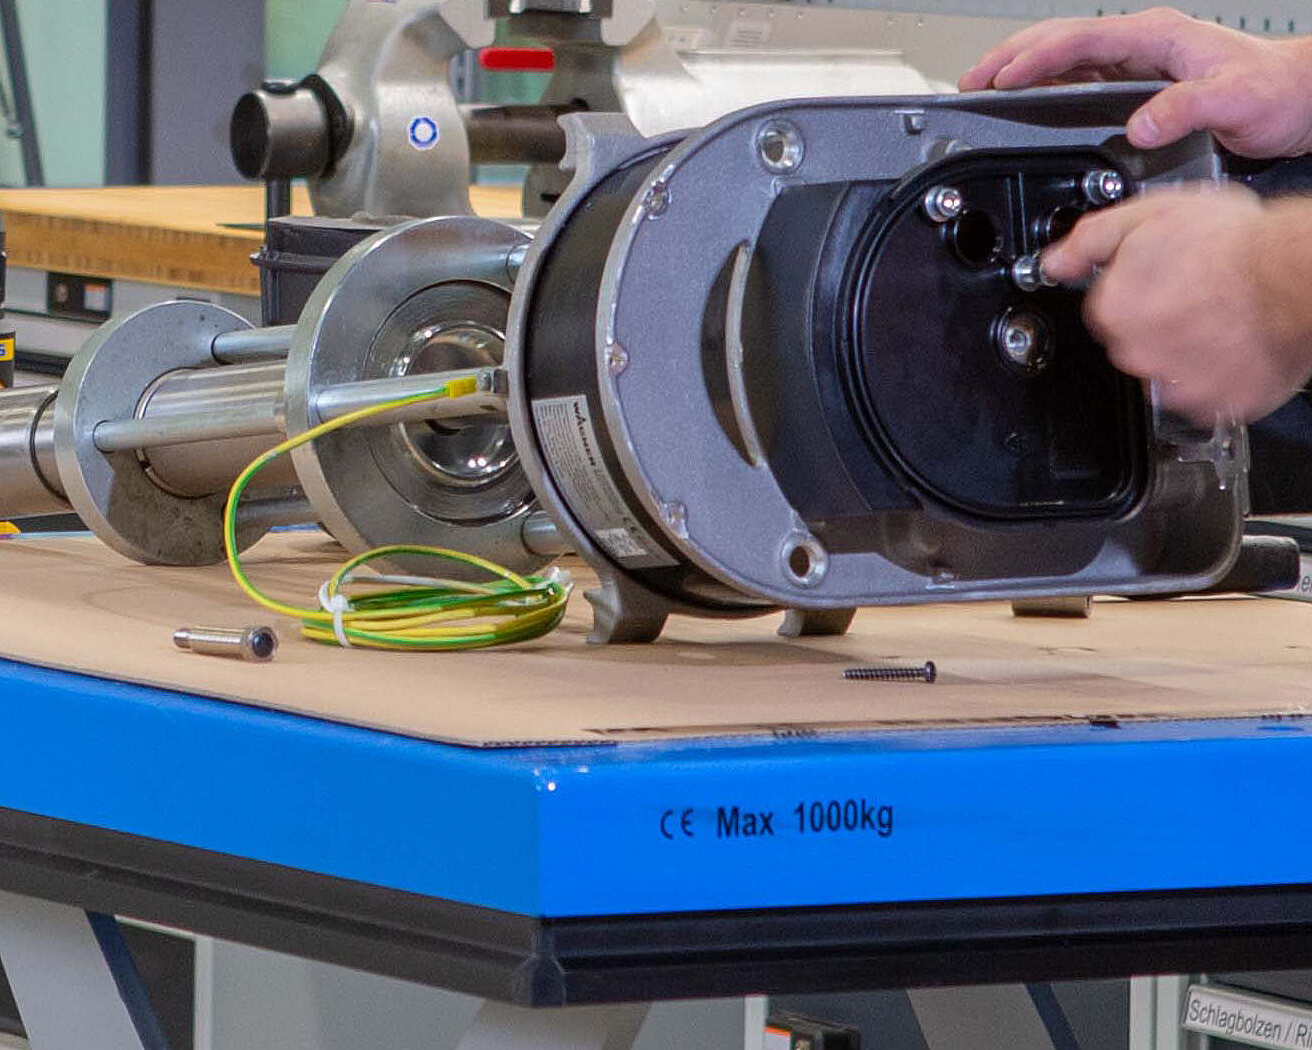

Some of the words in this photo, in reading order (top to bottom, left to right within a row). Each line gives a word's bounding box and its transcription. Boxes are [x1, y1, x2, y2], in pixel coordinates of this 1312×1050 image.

[716, 805, 775, 839] Max
[793, 797, 894, 838] 1000kg
[1189, 997, 1283, 1041] Schlagbolzen
